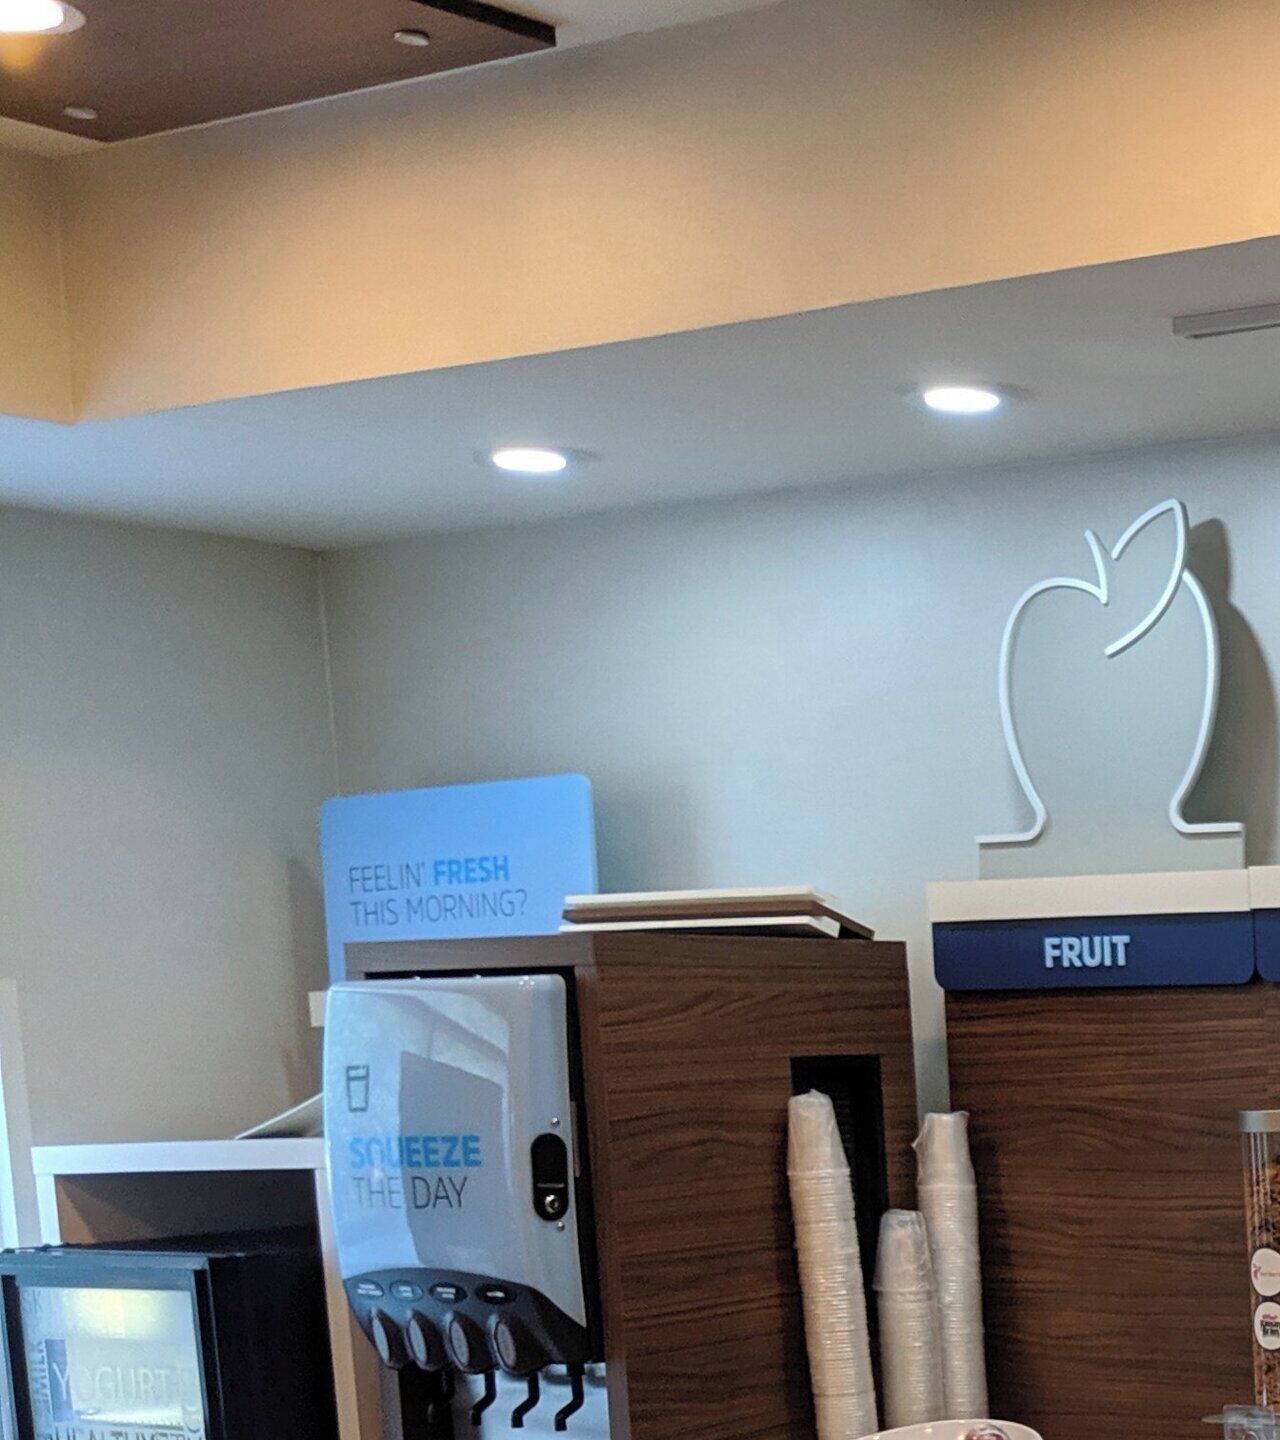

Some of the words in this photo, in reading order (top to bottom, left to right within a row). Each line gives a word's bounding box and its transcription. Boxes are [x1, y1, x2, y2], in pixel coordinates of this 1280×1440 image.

[349, 861, 426, 894] FEELIN'
[432, 855, 511, 887] FRESH
[350, 898, 400, 927] THIS
[406, 888, 528, 924] MORNING?
[1043, 934, 1131, 969] FRUIT
[350, 1134, 482, 1169] SQUEEZE
[352, 1175, 402, 1209] THE
[411, 1175, 468, 1209] DAY
